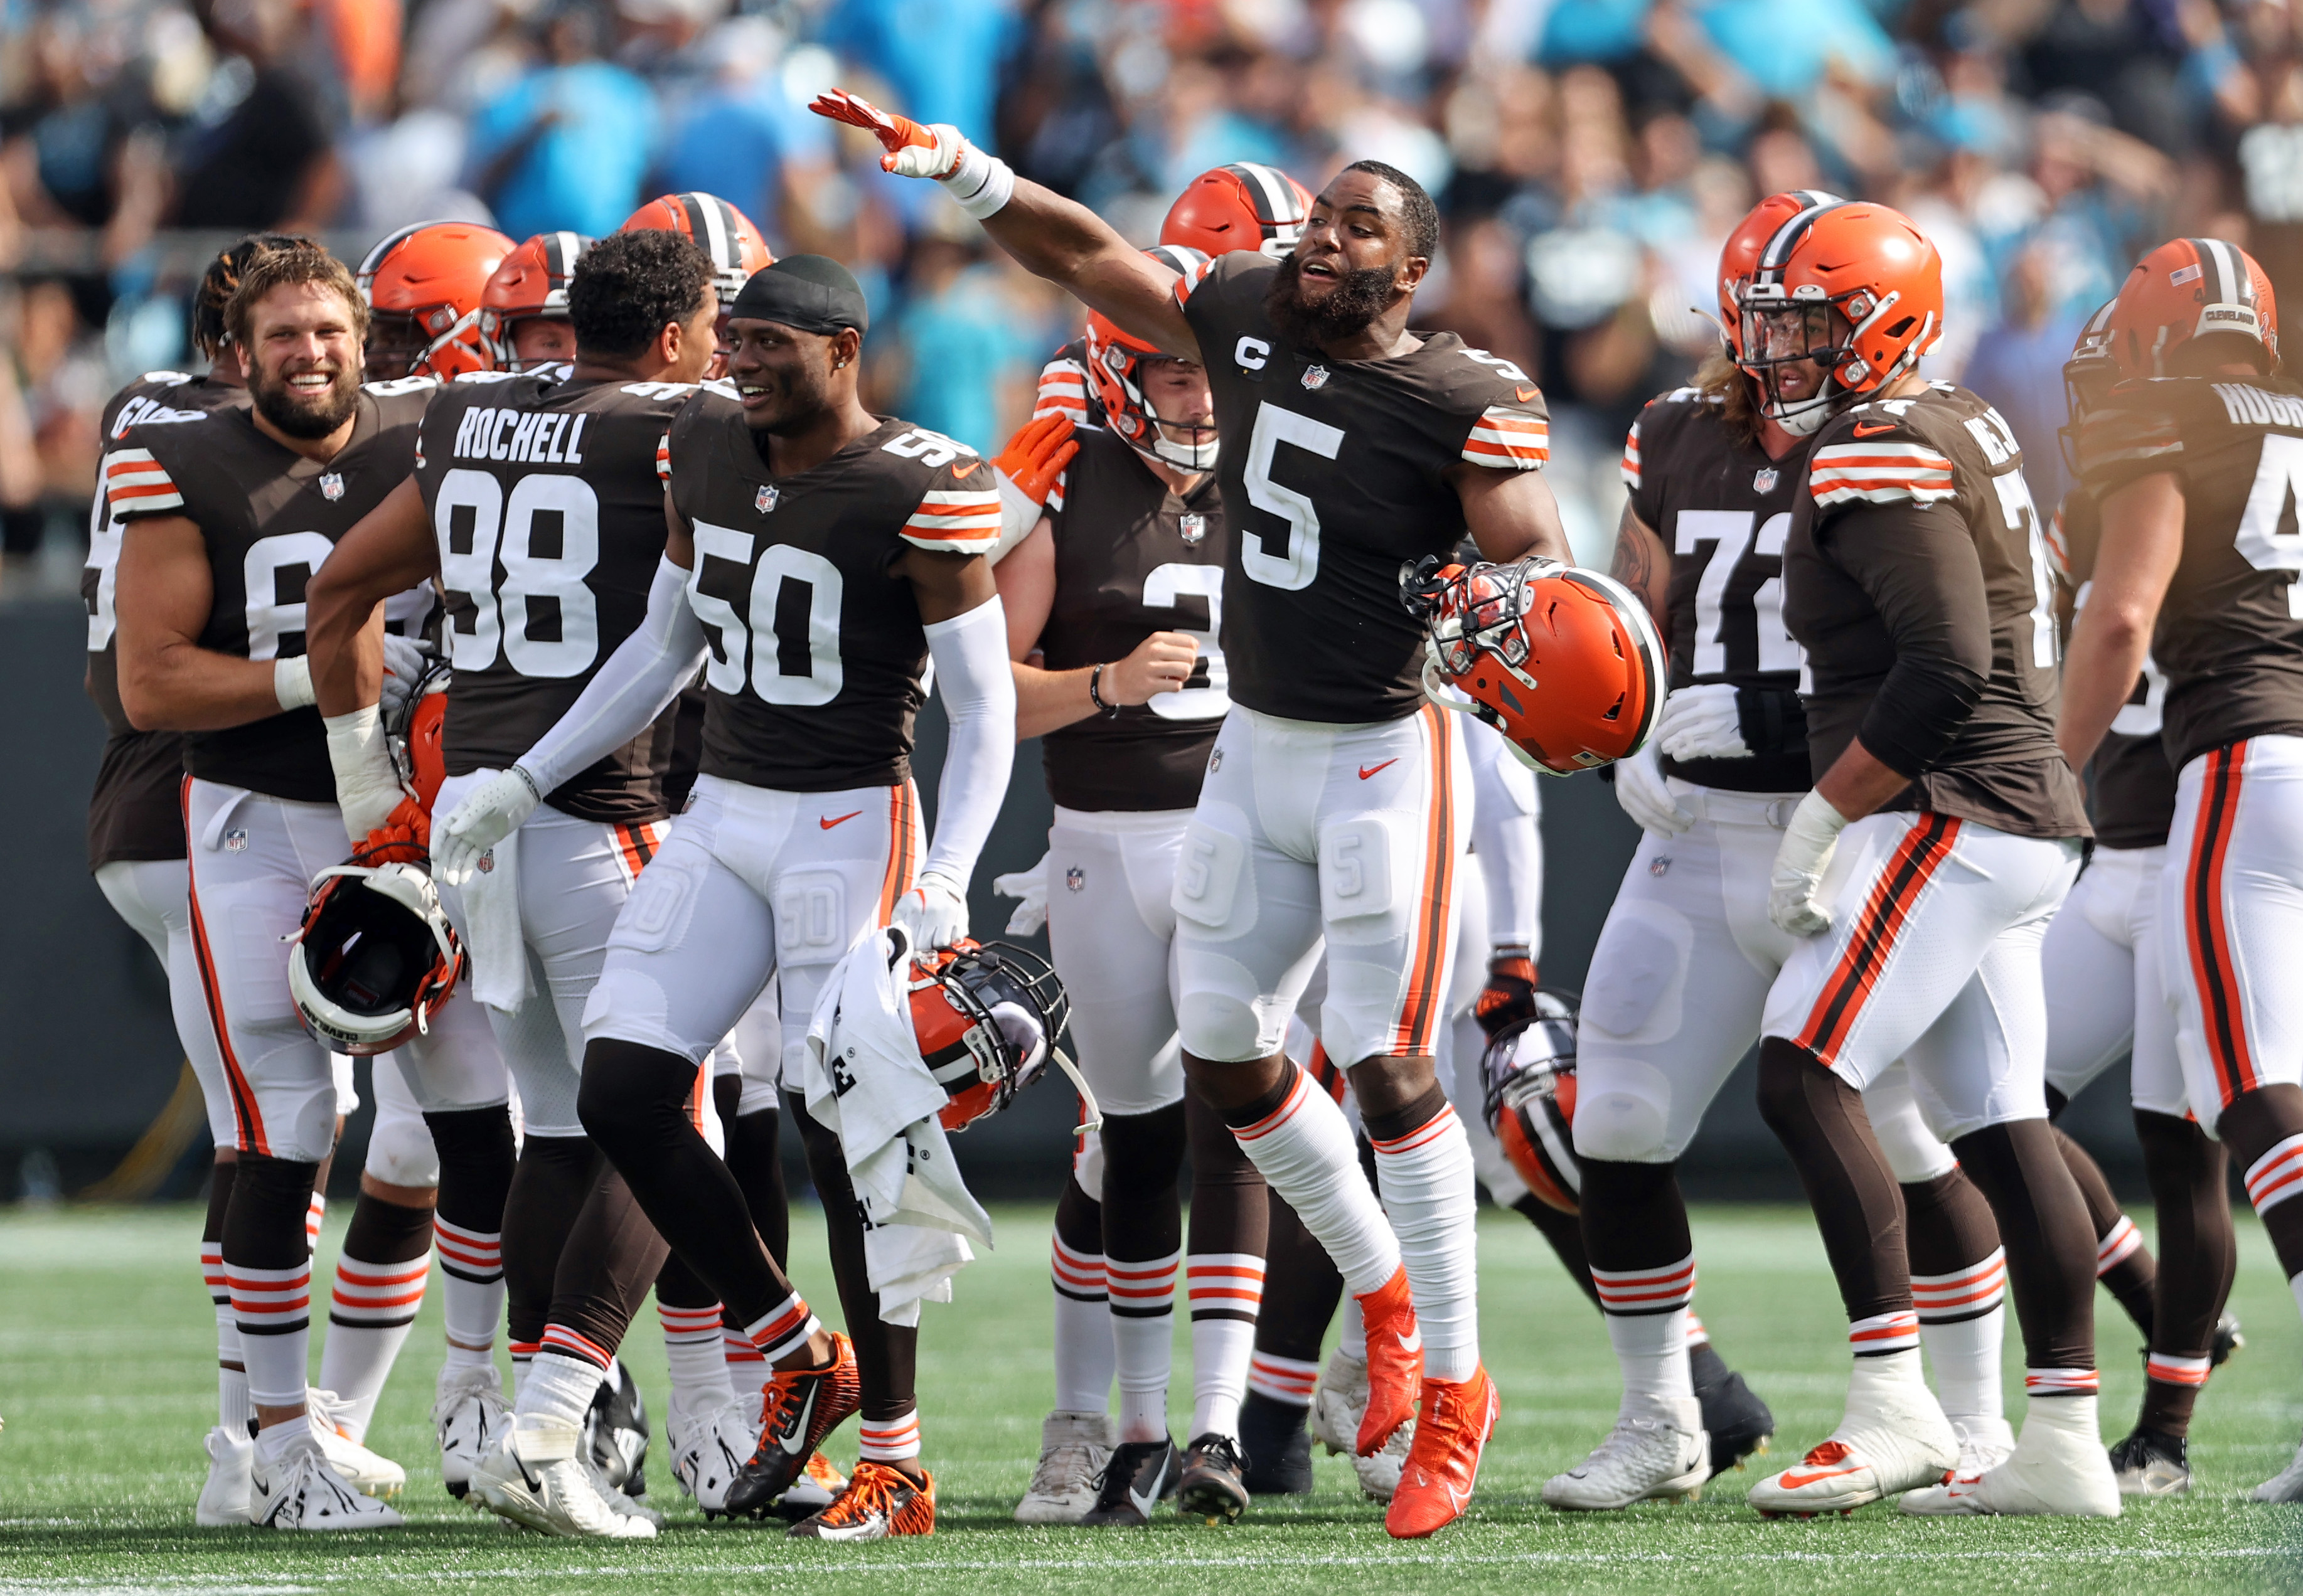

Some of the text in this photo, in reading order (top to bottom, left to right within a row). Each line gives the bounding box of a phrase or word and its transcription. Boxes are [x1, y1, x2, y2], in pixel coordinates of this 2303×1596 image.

[2205, 310, 2255, 326] CLEVELAND
[1234, 336, 1270, 370] C
[1458, 349, 1529, 381] 5
[453, 406, 587, 464] ROCHELL
[1242, 400, 1345, 591] 5
[435, 468, 598, 678] 98
[1675, 510, 1800, 676] 72
[686, 517, 843, 706] 50
[1142, 563, 1234, 720] 3
[1332, 836, 1365, 898] 5
[299, 1000, 358, 1041] CLEVELAND
